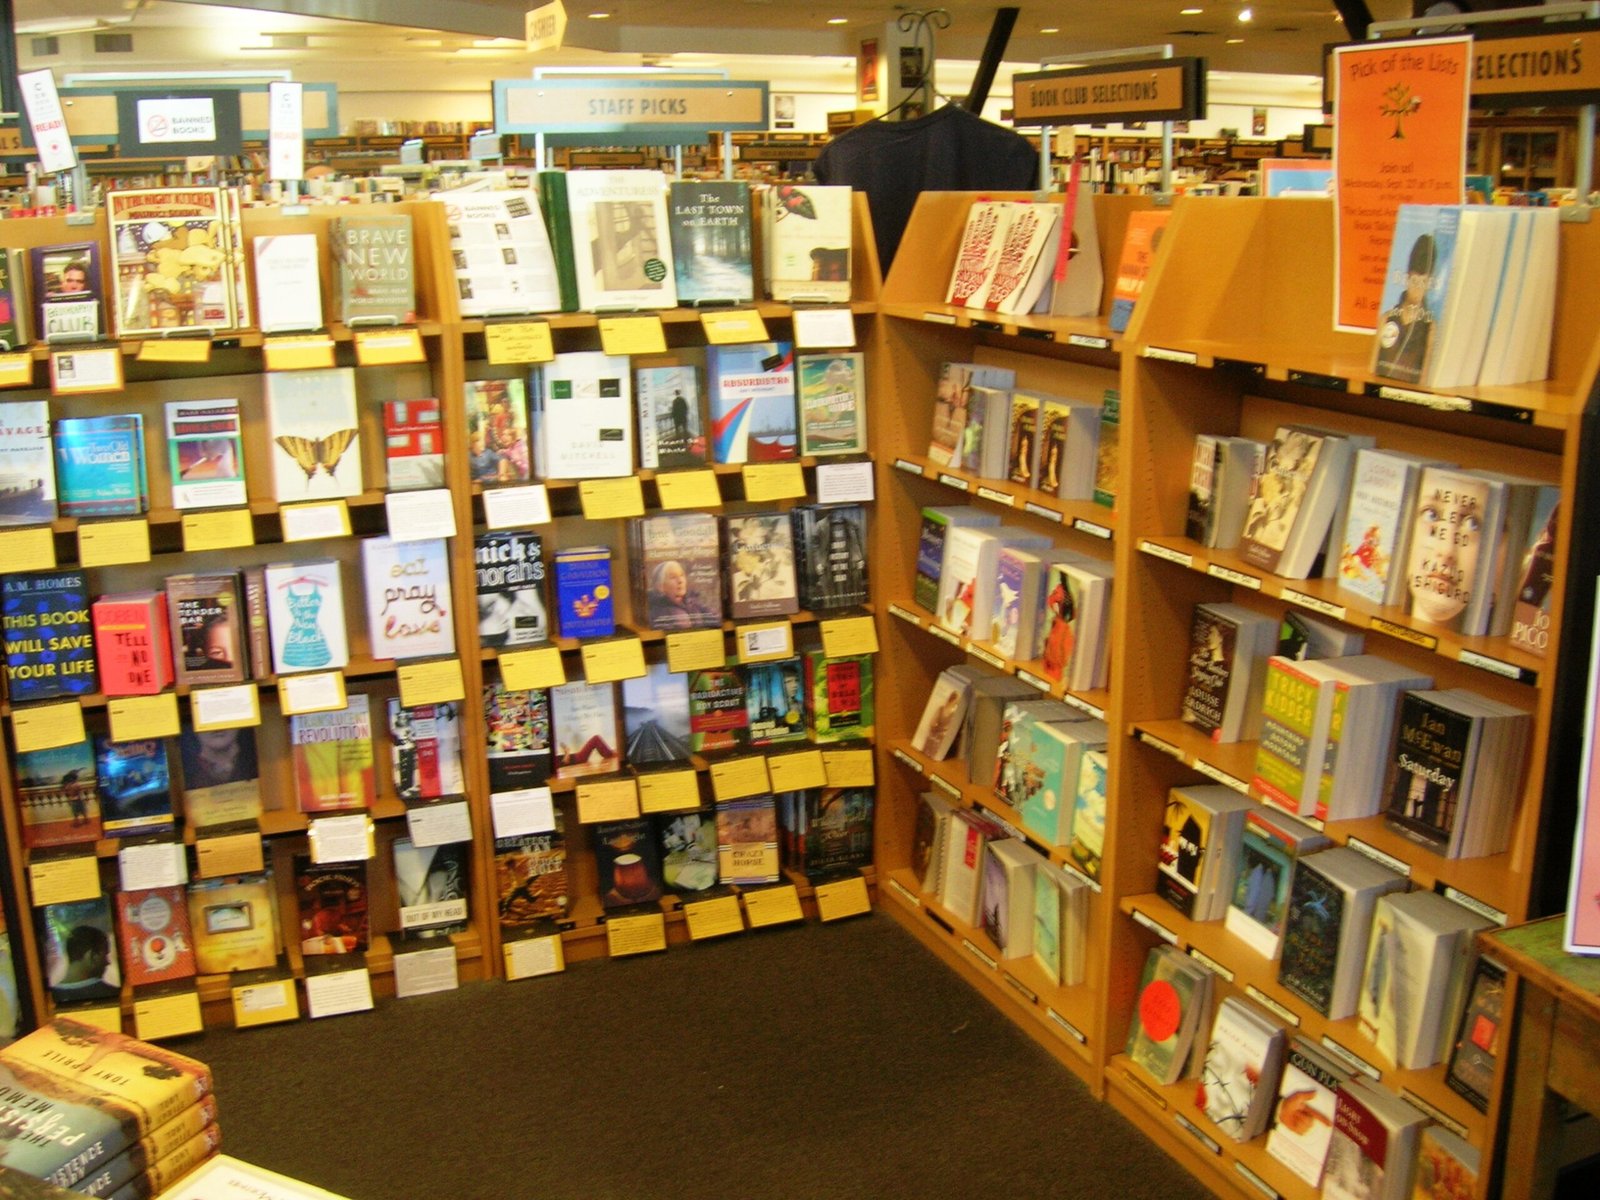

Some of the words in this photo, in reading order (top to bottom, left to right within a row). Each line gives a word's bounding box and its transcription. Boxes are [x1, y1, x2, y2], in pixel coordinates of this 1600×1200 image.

[1350, 58, 1378, 80] Pick
[1382, 53, 1397, 73] of
[1401, 53, 1424, 71] the
[1429, 54, 1460, 76] Lists
[1473, 49, 1582, 80] ELECTIONS
[1031, 87, 1058, 108] BOOK
[1063, 85, 1088, 105] CLUB
[1092, 81, 1158, 103] SELECTIONS
[588, 98, 634, 116] STAFF
[640, 98, 688, 115] PICKS
[172, 115, 212, 124] BANNED
[173, 126, 207, 134] BOOKS
[699, 194, 720, 203] The
[675, 206, 704, 215] LAST
[708, 205, 744, 214] TOWN
[698, 217, 738, 226] EARTH
[346, 229, 407, 245] BRAVE
[346, 248, 409, 265] NEW
[348, 268, 409, 281] WORLD
[1433, 487, 1477, 508] NEVER
[475, 536, 526, 564] nick
[390, 558, 430, 578] eat
[4, 580, 33, 592] A.M.
[35, 577, 82, 591] HOMES
[178, 601, 200, 609] THE
[381, 583, 440, 616] pray
[3, 613, 37, 629] THIS
[40, 609, 90, 627] BOOK
[179, 608, 223, 617] TENDER
[180, 616, 203, 624] BAR
[1533, 608, 1549, 630] JO
[384, 614, 442, 641] love
[1511, 621, 1548, 649] PICO
[6, 639, 45, 655] WILL
[49, 634, 93, 651] SAVE
[116, 632, 148, 647] TELL
[131, 649, 148, 665] NO
[8, 664, 57, 680] YOUR
[61, 660, 95, 675] LIFE
[129, 670, 152, 686] ONE
[691, 688, 745, 700] RADIOACTIVE
[714, 699, 741, 709] SCOUT
[1419, 712, 1446, 736] Ian
[299, 724, 370, 743] REVOLUTION
[1398, 752, 1456, 793] Saturday
[732, 858, 765, 867] HORSE
[93, 1070, 130, 1087] TONY
[0, 1086, 54, 1115] MEMO
[0, 1105, 86, 1148] PERSIS
